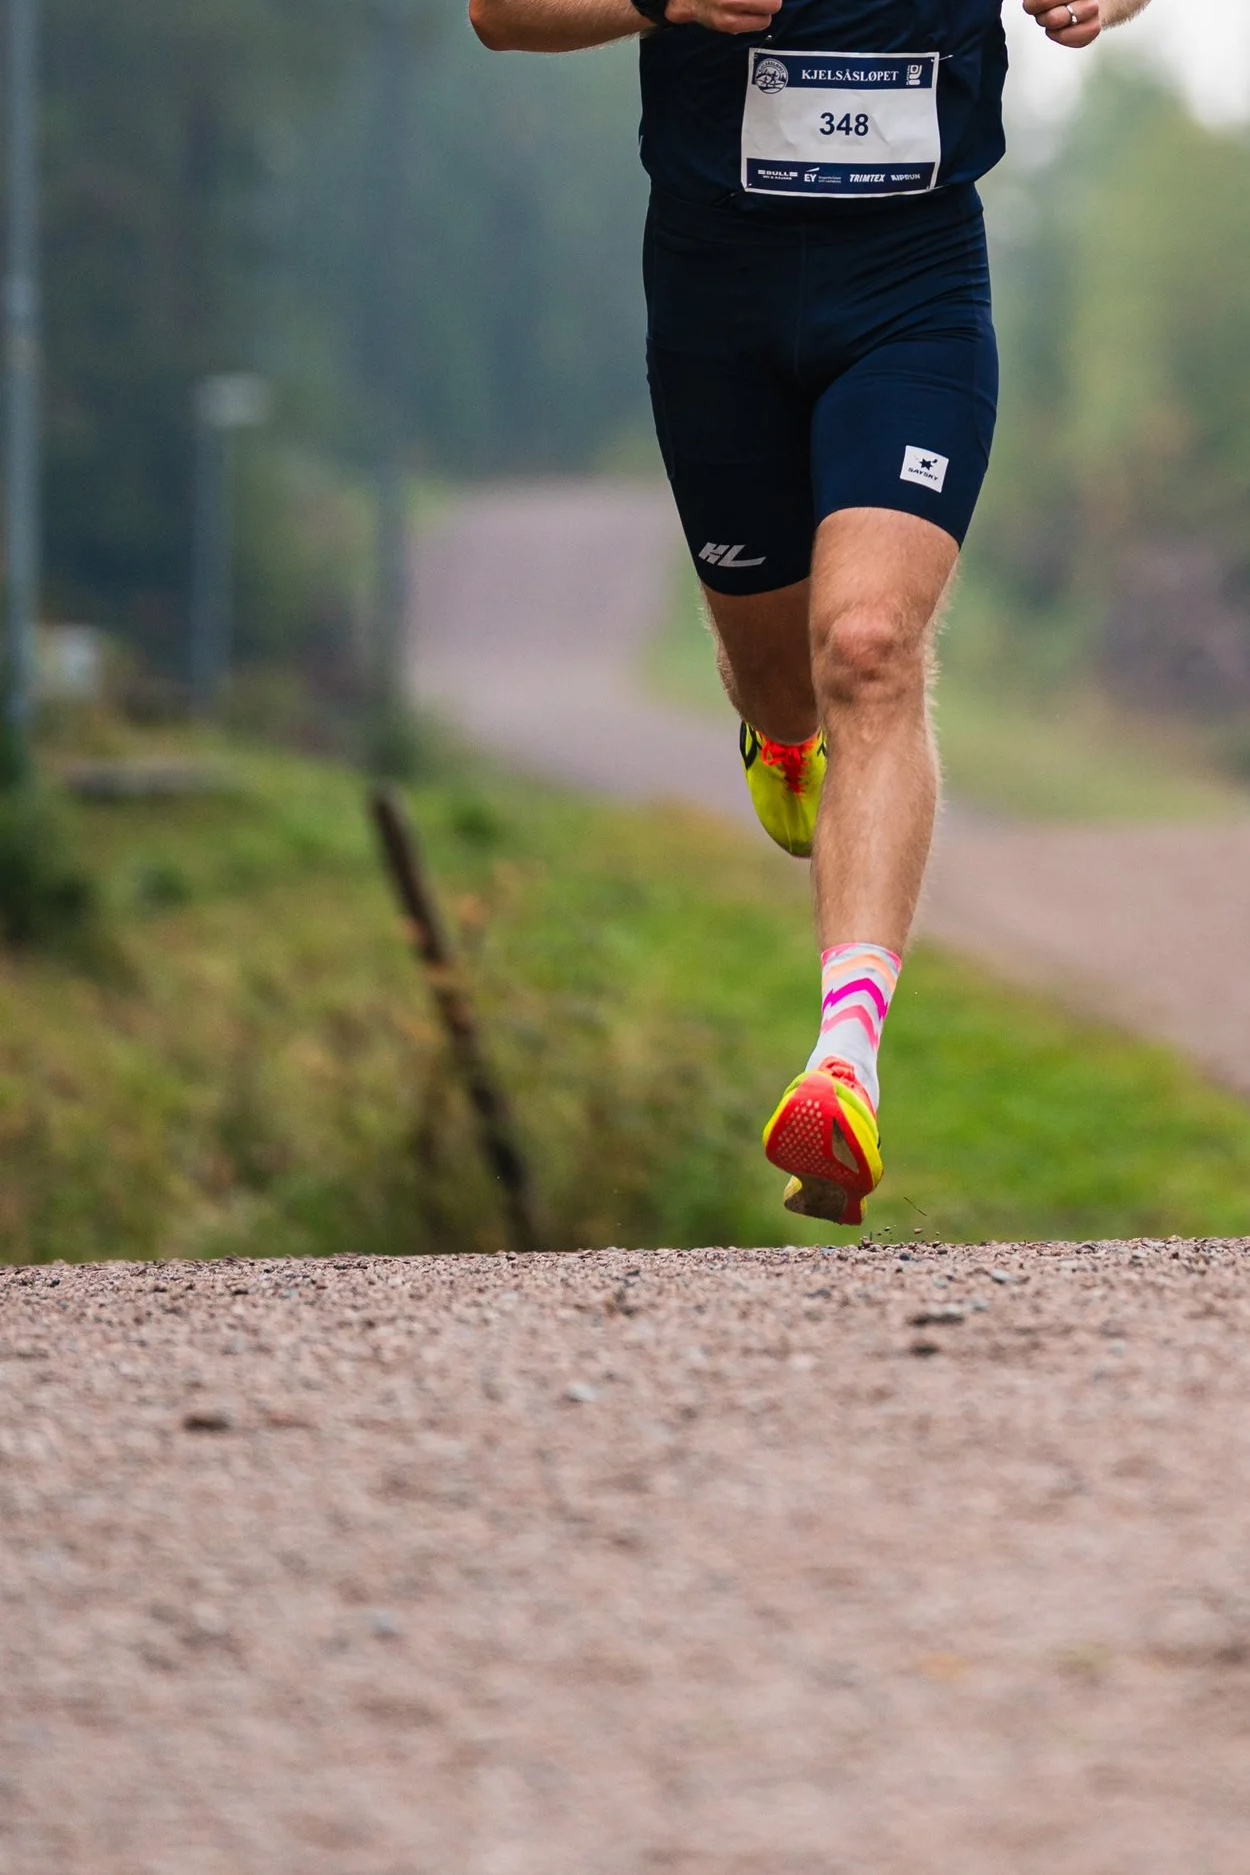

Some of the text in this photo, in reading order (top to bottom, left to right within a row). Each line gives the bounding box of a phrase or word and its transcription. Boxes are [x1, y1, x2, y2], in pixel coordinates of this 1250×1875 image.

[801, 69, 899, 82] KJELSÅSLØPET
[819, 112, 869, 136] 348
[804, 173, 817, 183] EY
[849, 174, 886, 183] TRIMTEX
[907, 466, 939, 482] SAYSKY
